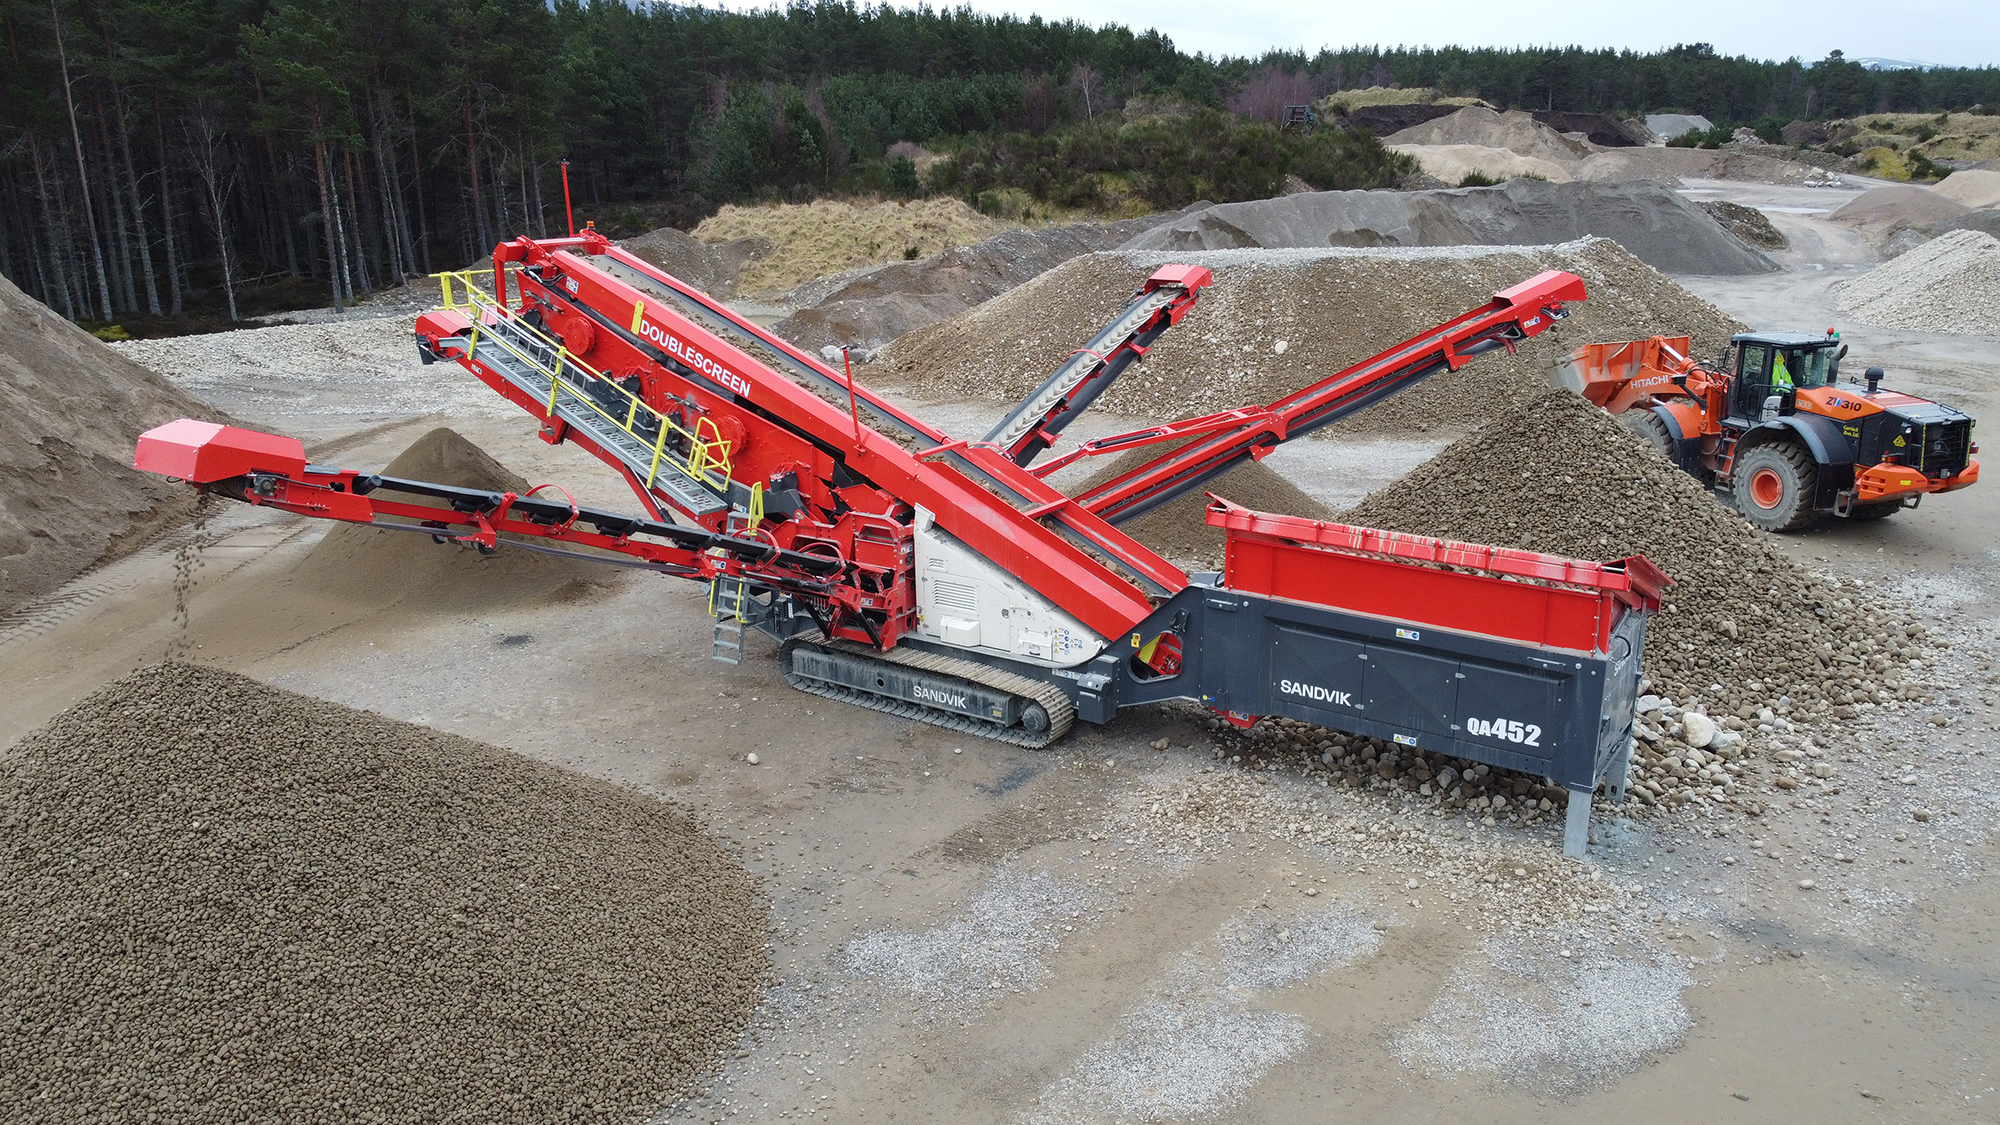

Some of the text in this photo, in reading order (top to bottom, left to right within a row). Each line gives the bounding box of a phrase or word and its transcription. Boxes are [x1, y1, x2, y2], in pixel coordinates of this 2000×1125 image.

[640, 319, 751, 398] DOUBLESCREEN
[1630, 375, 1669, 389] HITACHI
[1796, 399, 1813, 410] eco
[1826, 396, 1862, 411] ZW310
[913, 685, 967, 709] SANDVIK
[1280, 679, 1352, 707] SANDVIK
[1466, 717, 1542, 747] QA452
